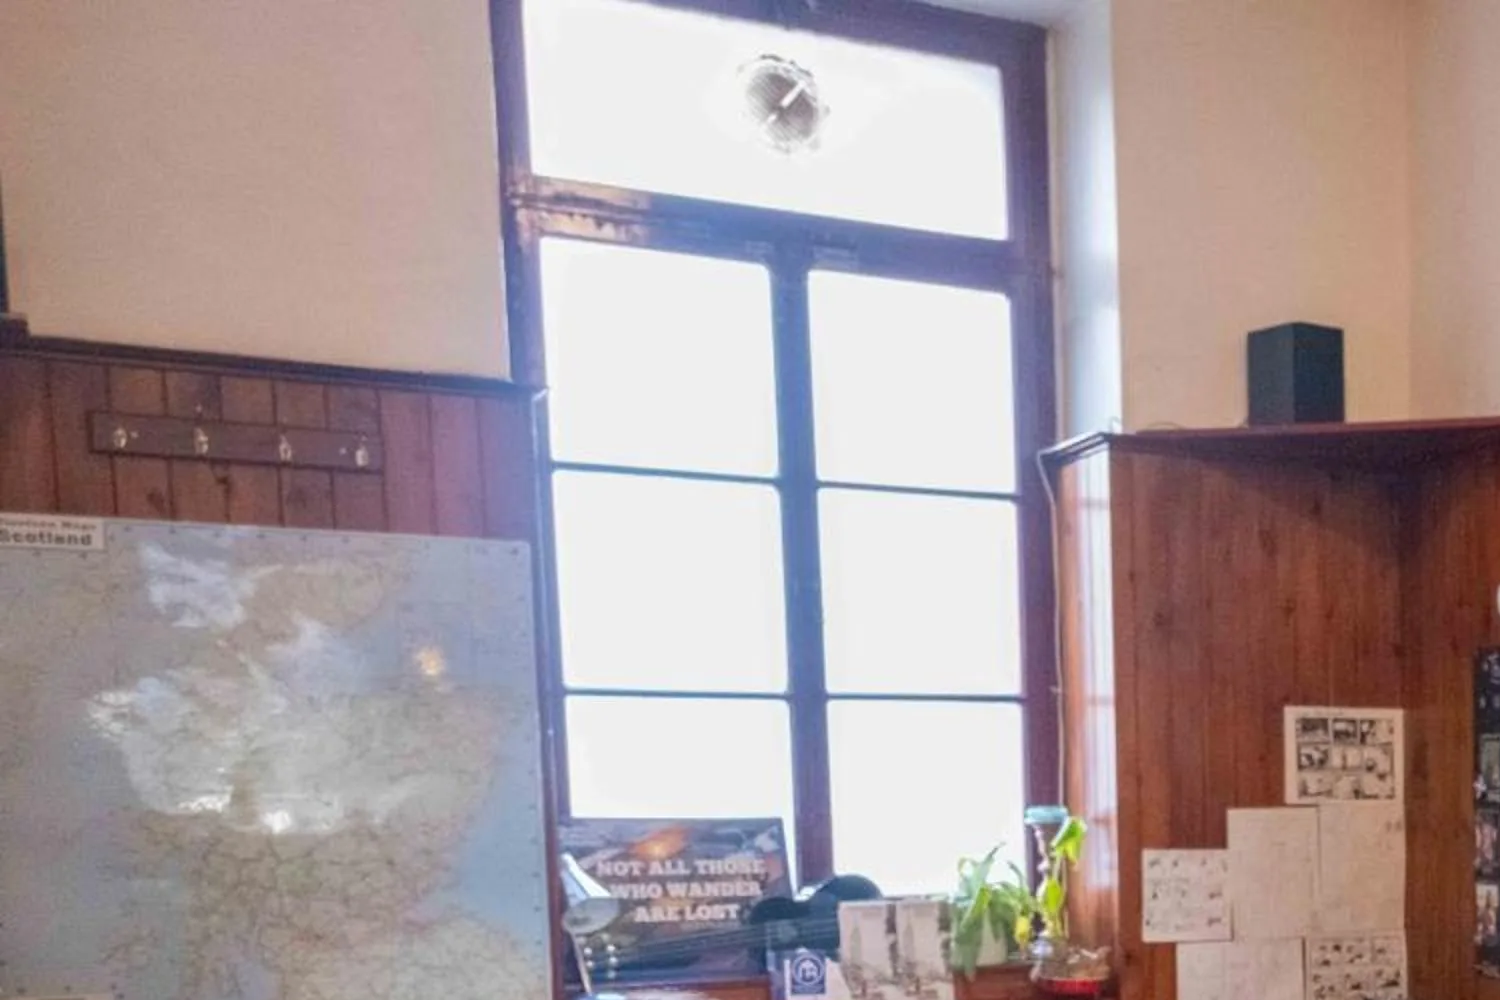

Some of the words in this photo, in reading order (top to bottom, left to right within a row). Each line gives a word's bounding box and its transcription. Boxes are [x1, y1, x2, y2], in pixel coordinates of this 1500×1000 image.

[0, 528, 92, 546] Scotland
[596, 859, 647, 877] NOT
[649, 859, 691, 876] ALL
[694, 858, 766, 877] THOSE
[611, 882, 664, 899] WHO
[665, 881, 762, 898] WANDER
[634, 905, 681, 923] ARE
[684, 904, 740, 921] LOST
